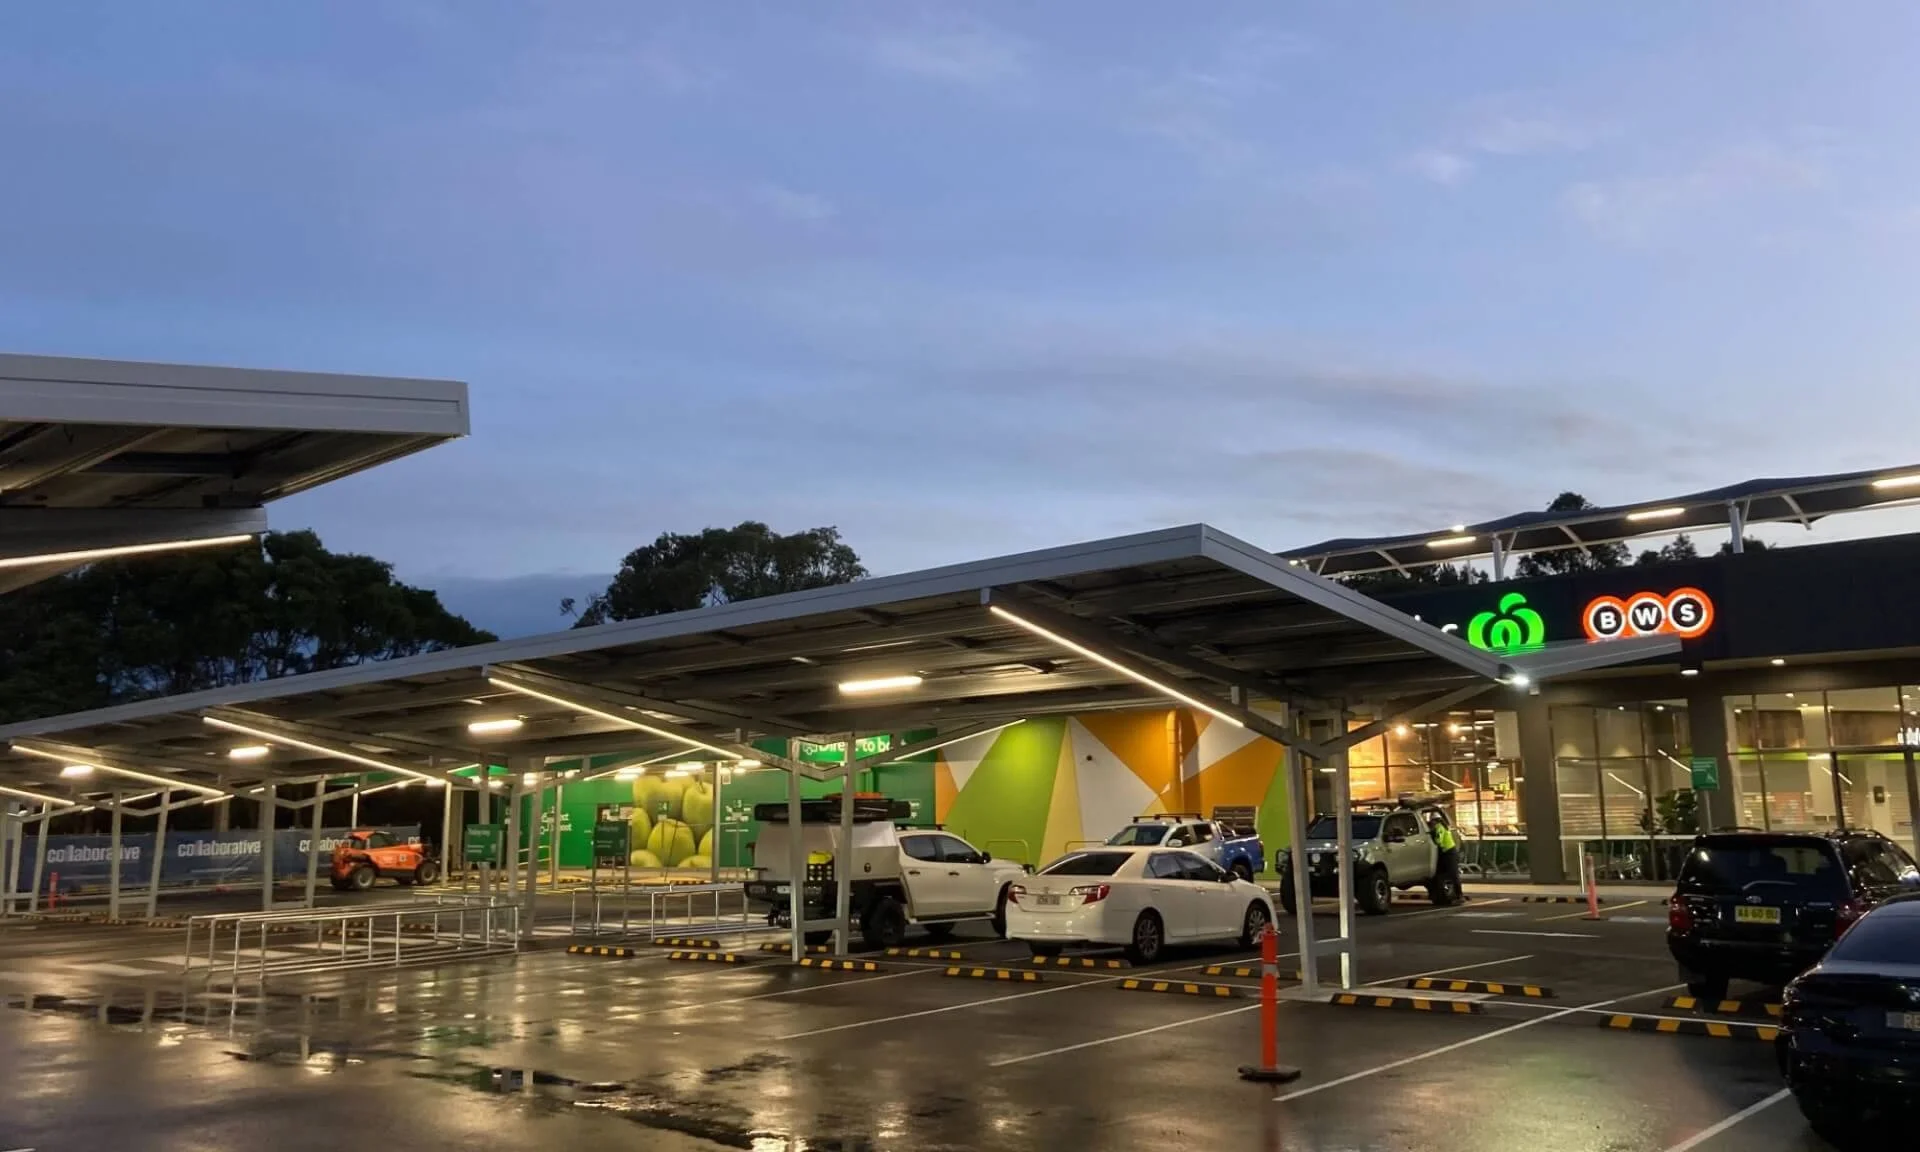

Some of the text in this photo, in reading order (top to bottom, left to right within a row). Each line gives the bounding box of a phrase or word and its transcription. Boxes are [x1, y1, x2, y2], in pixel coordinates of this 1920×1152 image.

[1600, 603, 1696, 630] BWS
[863, 740, 876, 752] to
[47, 845, 140, 863] collaboraive
[177, 840, 261, 857] collaborative
